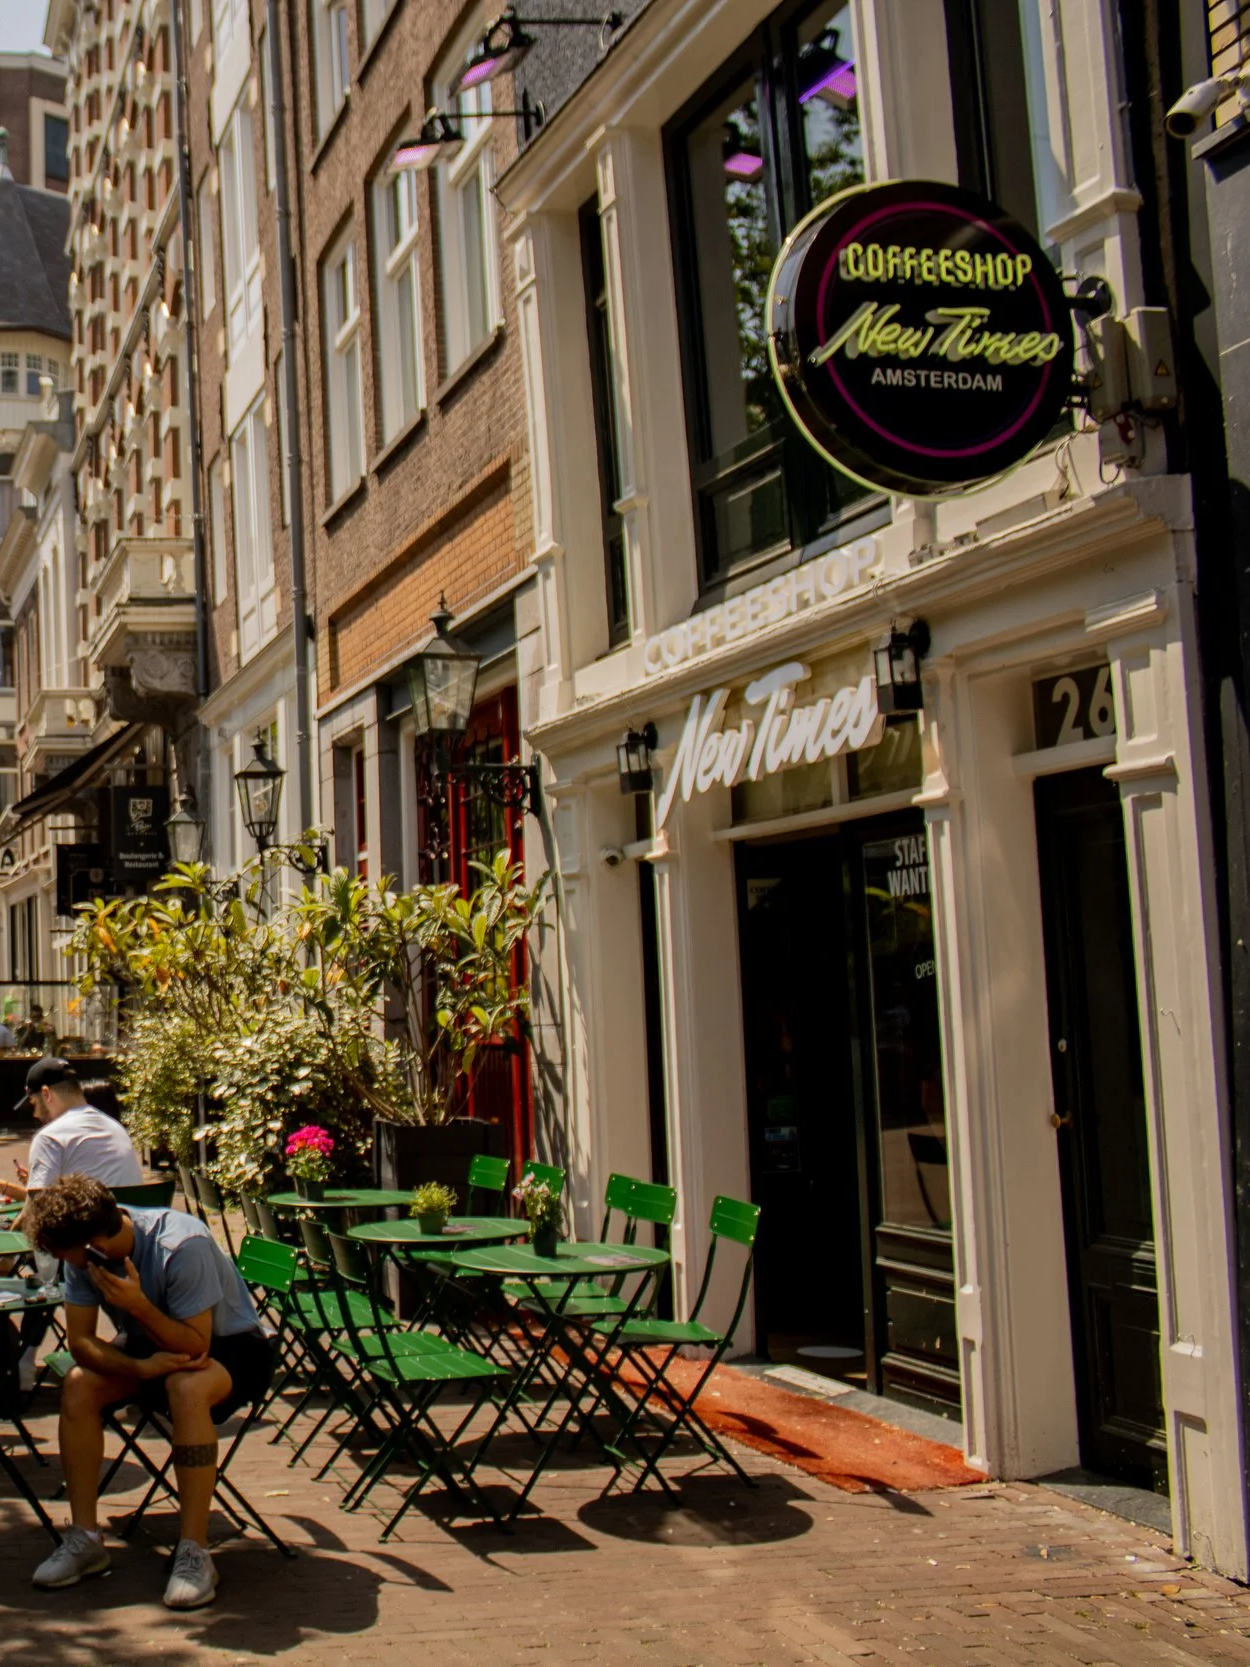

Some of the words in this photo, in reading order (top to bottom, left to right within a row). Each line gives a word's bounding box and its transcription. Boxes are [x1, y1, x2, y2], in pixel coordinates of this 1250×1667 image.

[844, 242, 1033, 287] COFFEESHOP
[812, 302, 935, 367] New
[933, 306, 1061, 362] Times
[871, 367, 1003, 391] AMSTERDAM
[643, 535, 880, 675] COFFEESHOP
[1052, 666, 1115, 747] 26
[656, 687, 754, 830] New
[744, 661, 879, 782] Times
